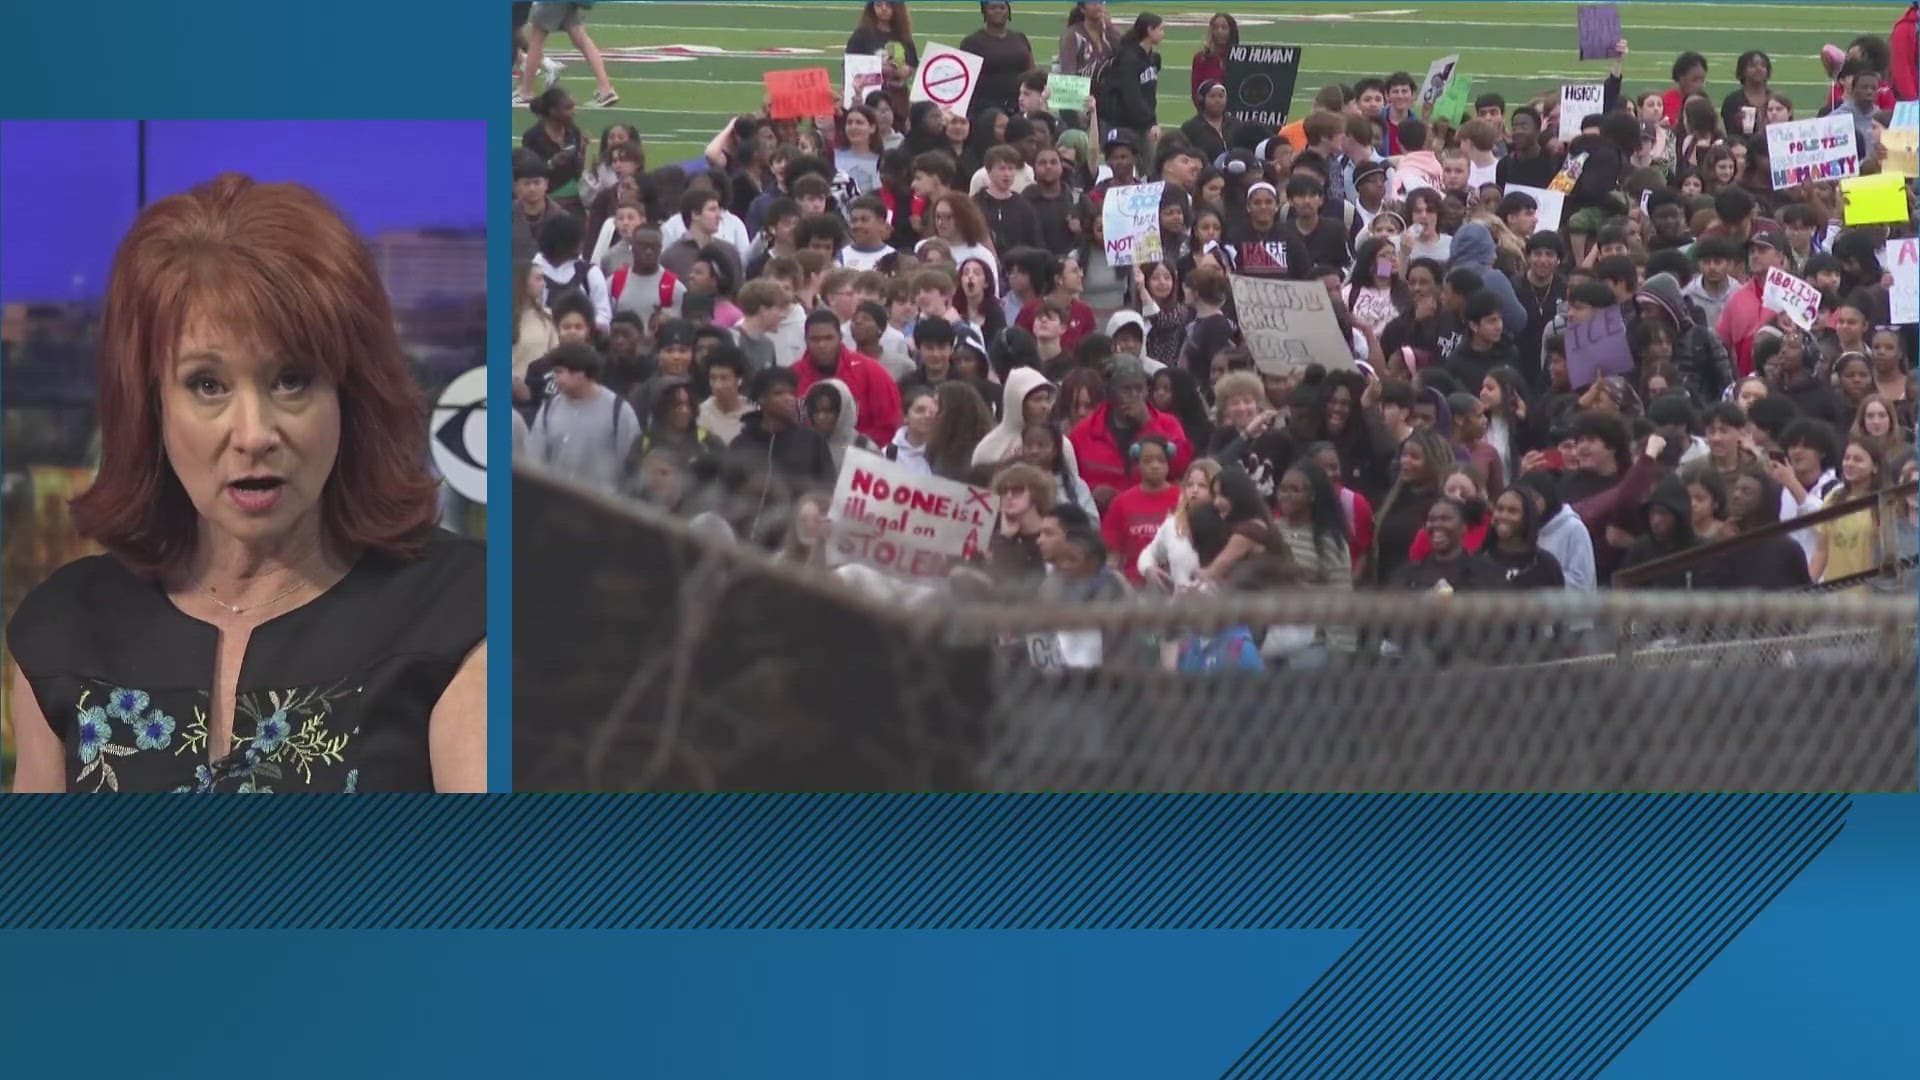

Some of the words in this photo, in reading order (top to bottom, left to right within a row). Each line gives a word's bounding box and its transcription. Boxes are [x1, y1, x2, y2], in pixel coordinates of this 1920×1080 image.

[1229, 46, 1247, 61] NO
[1248, 47, 1294, 64] HUMAN
[1773, 154, 1857, 186] HUMANITY
[1107, 235, 1134, 253] NOT
[1768, 270, 1820, 306] ABOLISH
[1568, 309, 1624, 352] ICE
[851, 468, 890, 500] NO
[893, 485, 952, 518] ONE
[842, 496, 909, 537] illegal
[912, 525, 936, 538] on
